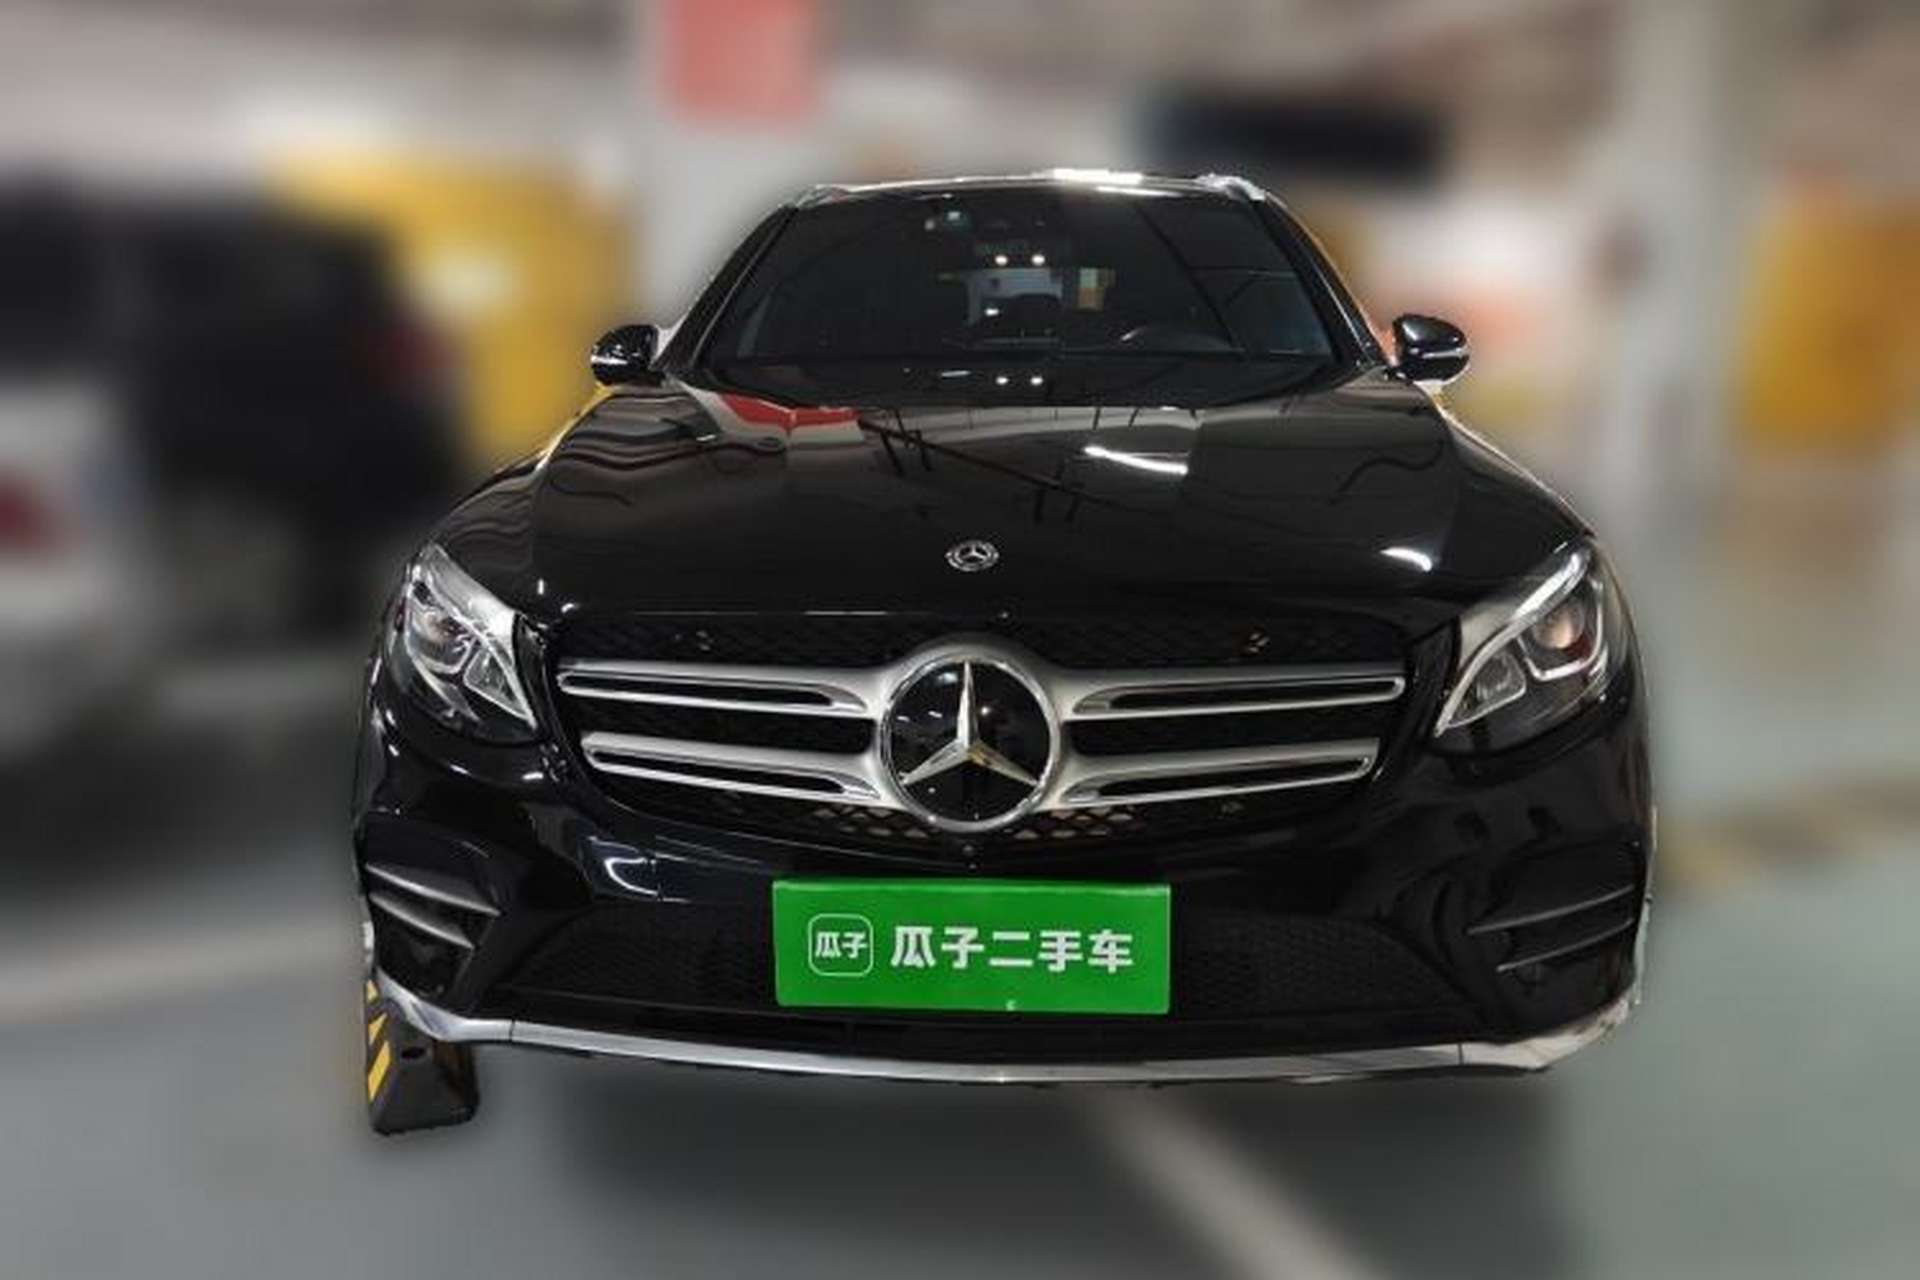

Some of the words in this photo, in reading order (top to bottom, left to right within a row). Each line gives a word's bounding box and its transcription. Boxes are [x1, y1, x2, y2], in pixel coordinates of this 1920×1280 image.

[815, 931, 868, 959] 瓜子
[890, 925, 1134, 973] 瓜子二手车
